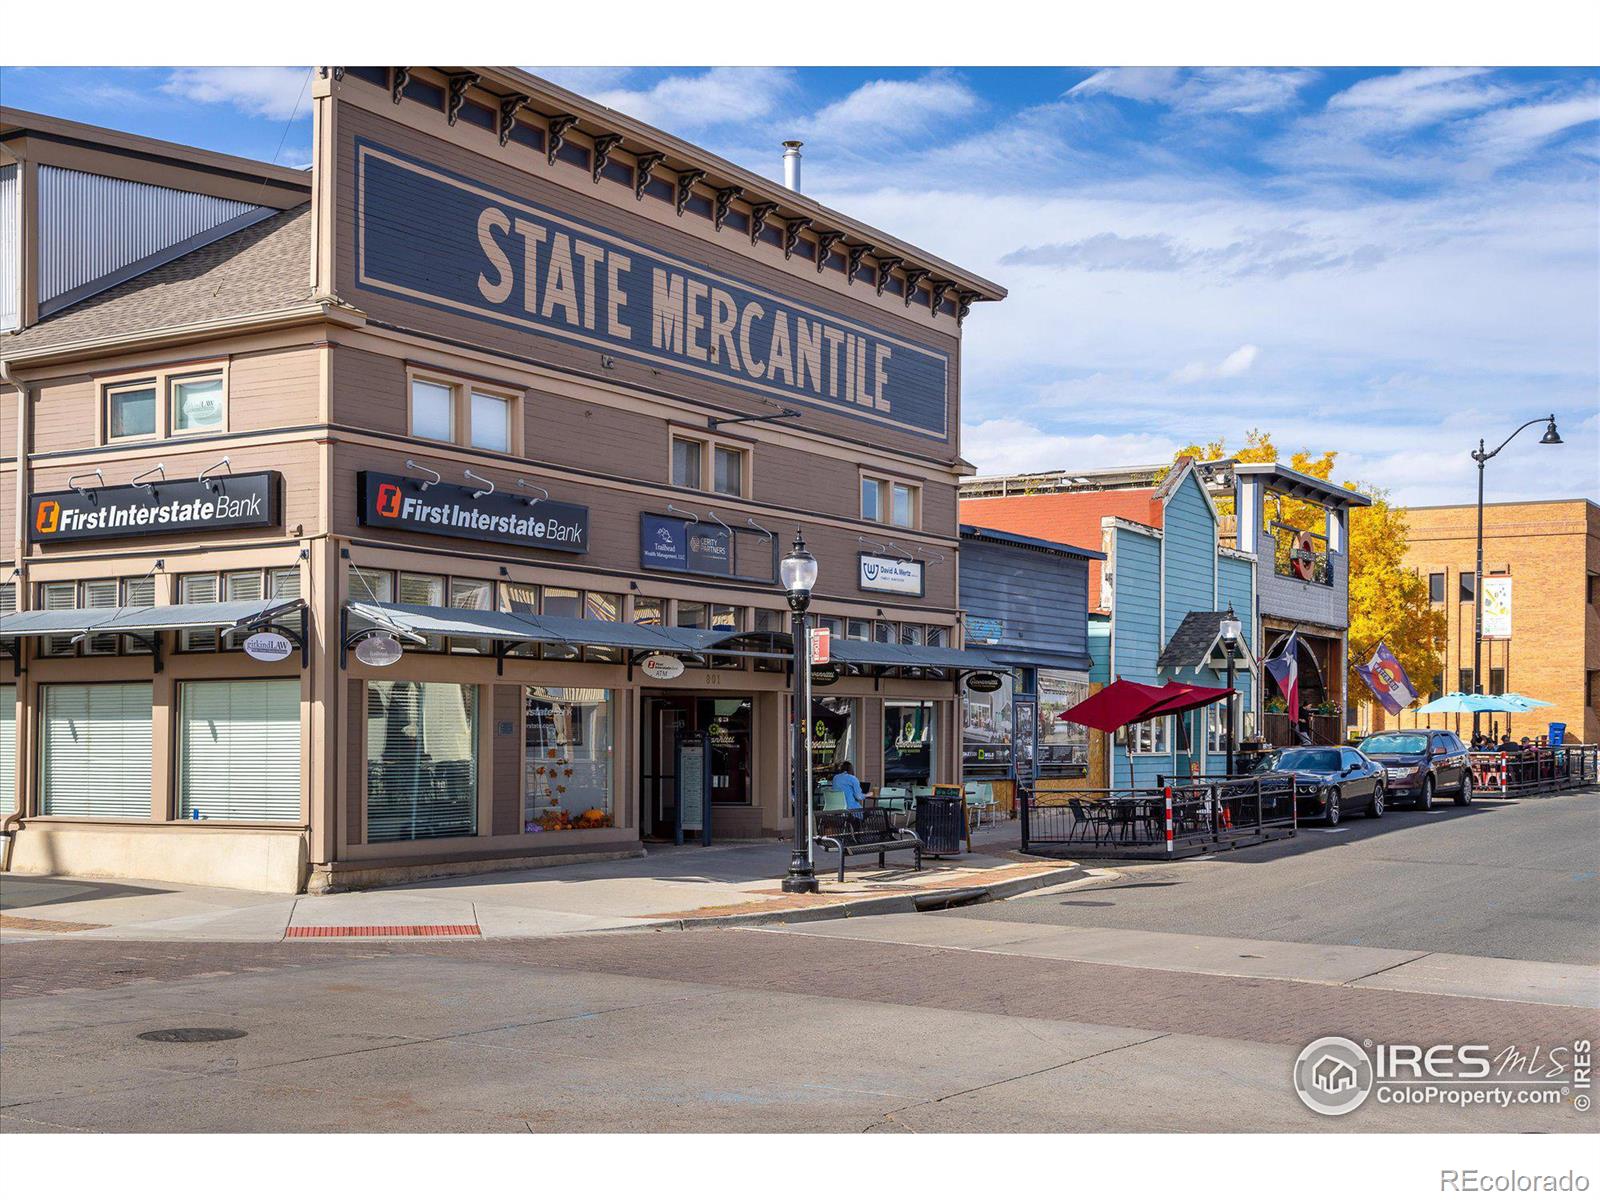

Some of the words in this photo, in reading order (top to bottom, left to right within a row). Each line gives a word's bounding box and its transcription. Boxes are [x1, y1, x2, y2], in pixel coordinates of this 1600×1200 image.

[477, 207, 632, 340] STATE
[652, 267, 892, 413] MERCANTILE
[215, 493, 261, 519] Bank
[547, 519, 583, 543] Bank
[706, 674, 720, 684] 801
